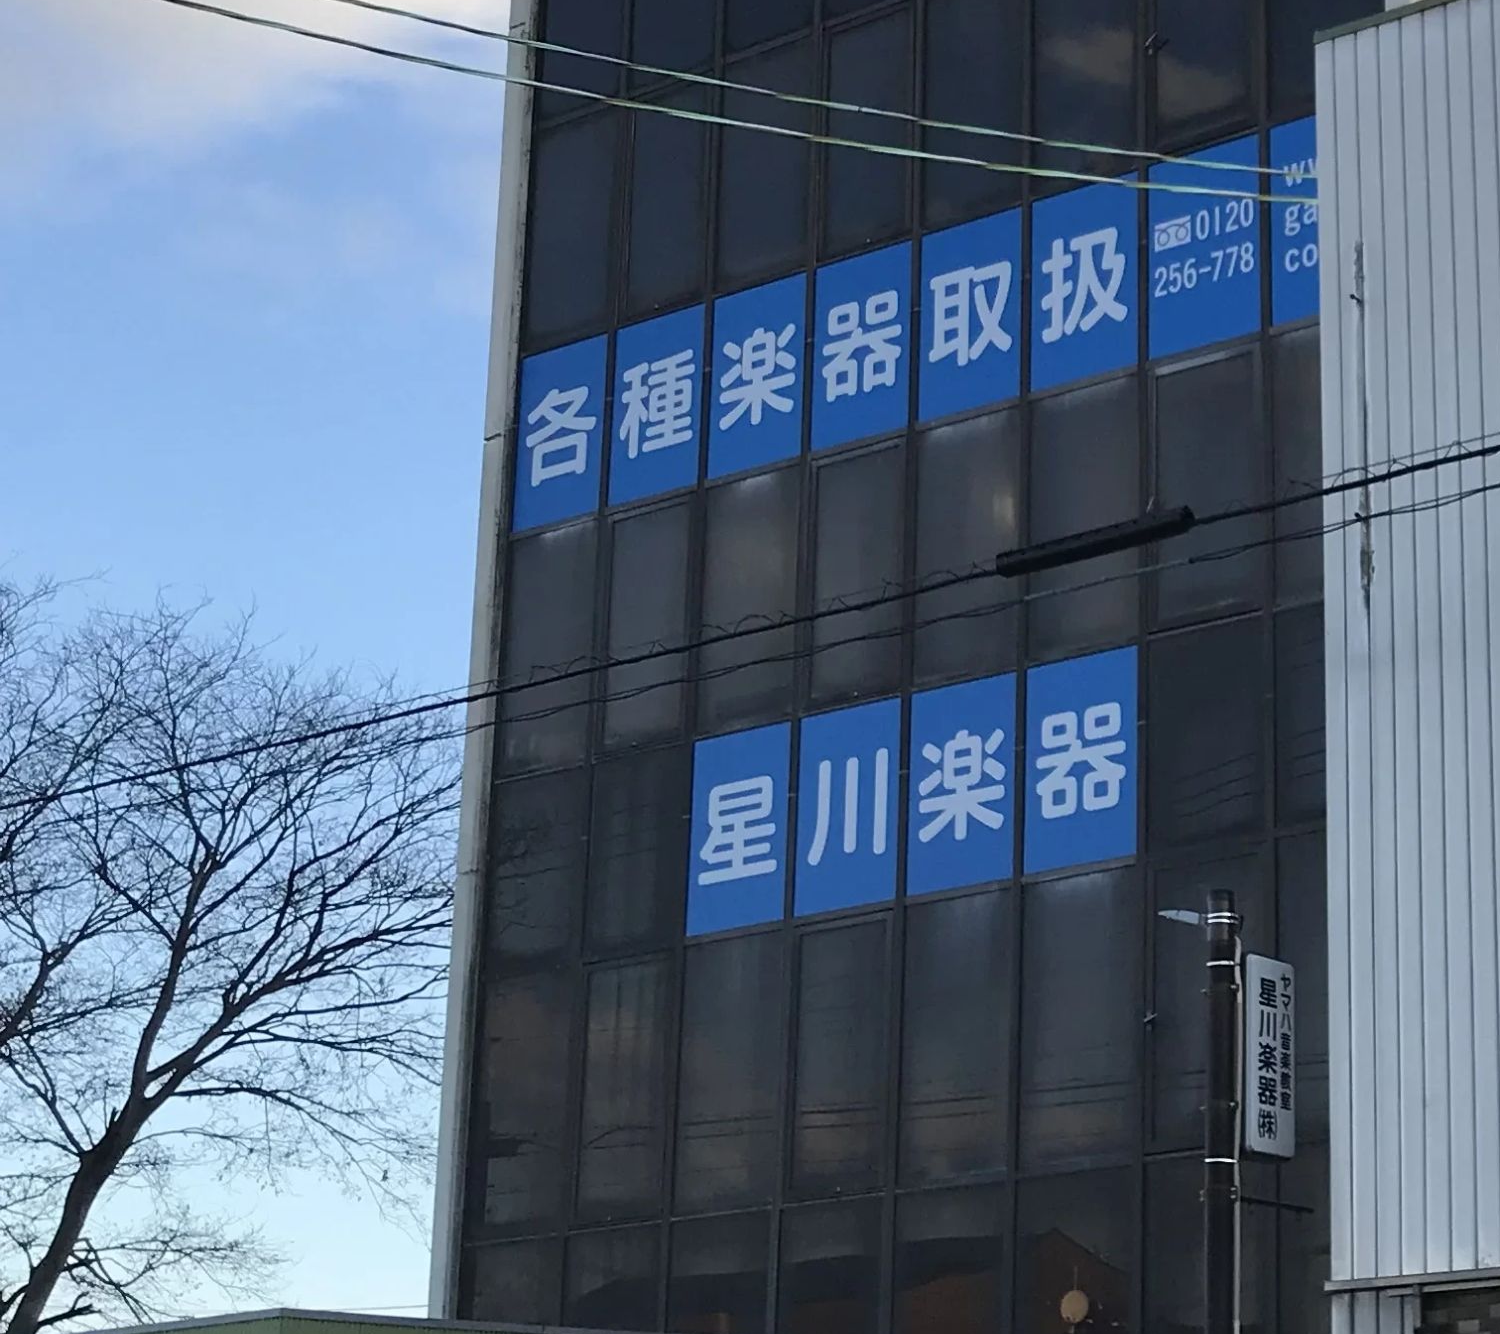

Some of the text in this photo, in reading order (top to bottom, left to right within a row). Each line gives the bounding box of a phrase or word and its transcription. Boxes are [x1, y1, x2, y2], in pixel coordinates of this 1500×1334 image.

[1153, 241, 1256, 298] 256-778
[1195, 198, 1255, 241] 0120
[524, 225, 1129, 488] 各種楽器取扱
[696, 700, 1128, 888] 星川楽器
